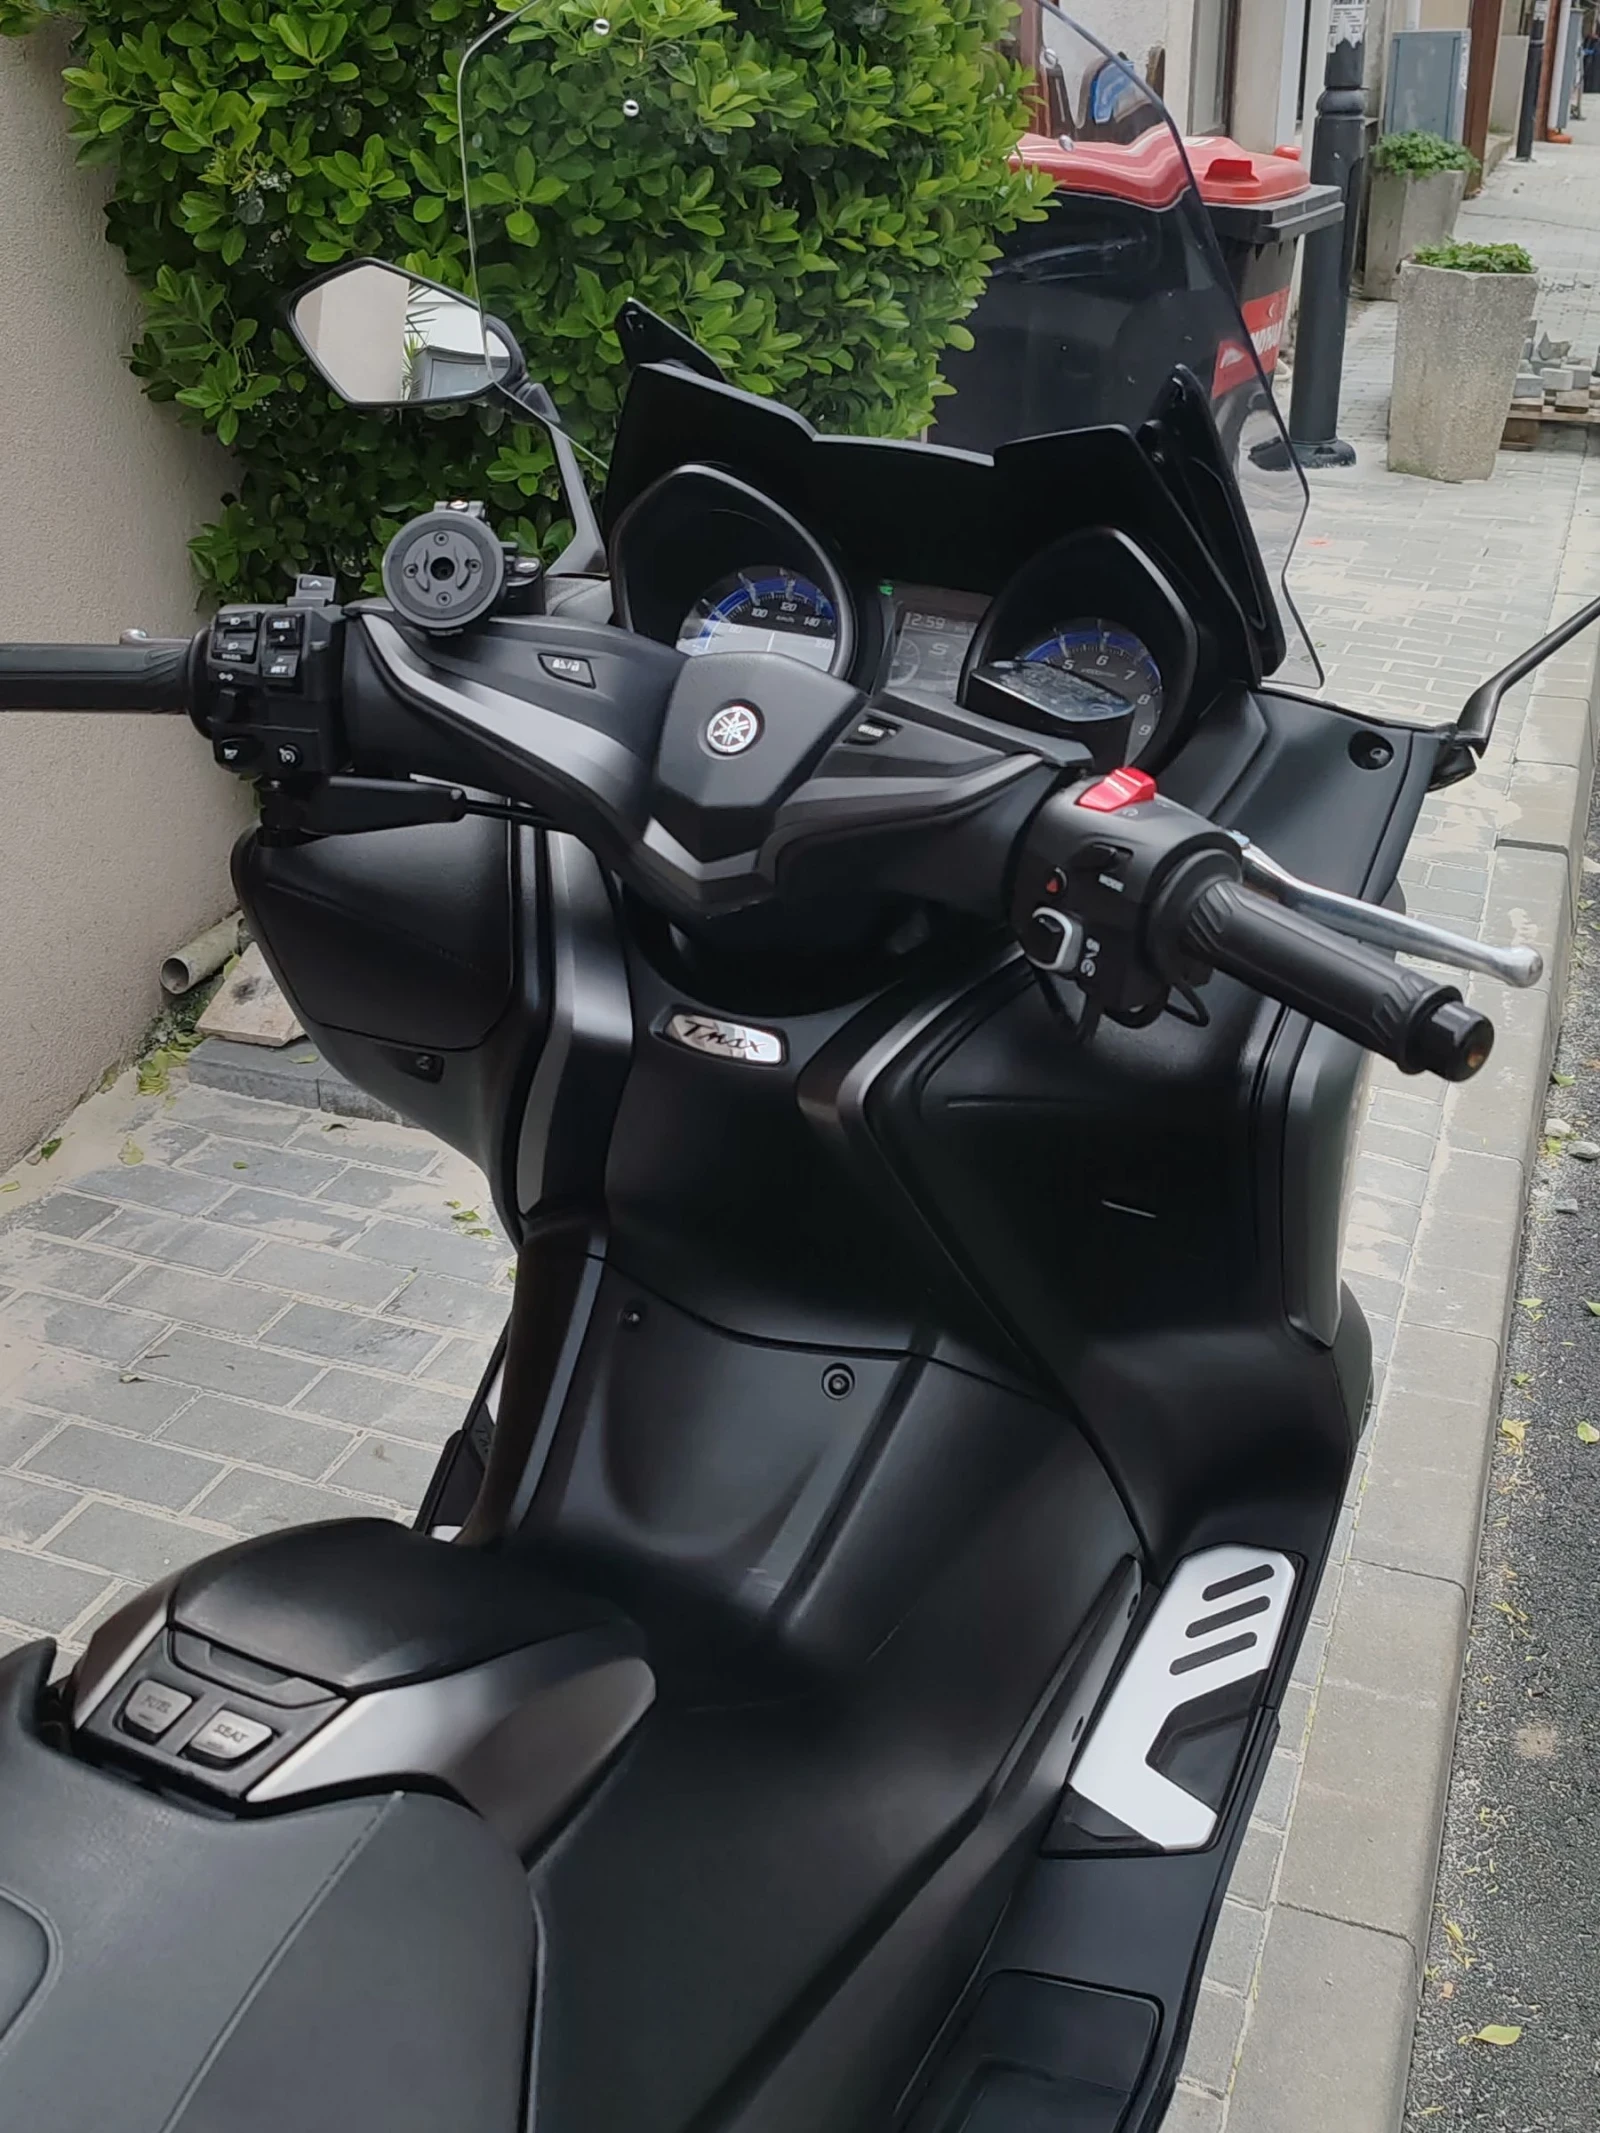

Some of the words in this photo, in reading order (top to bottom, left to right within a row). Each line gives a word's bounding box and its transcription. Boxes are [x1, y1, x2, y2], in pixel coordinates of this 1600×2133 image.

[780, 601, 797, 612] 120
[751, 607, 769, 618] 100
[803, 616, 821, 627] 140
[928, 642, 949, 656] S
[1062, 659, 1075, 670] 5
[1096, 655, 1109, 666] 6
[1123, 670, 1137, 681] 7
[1137, 693, 1151, 705] 8
[1138, 724, 1151, 736] 9
[212, 1722, 249, 1743] SEAT
